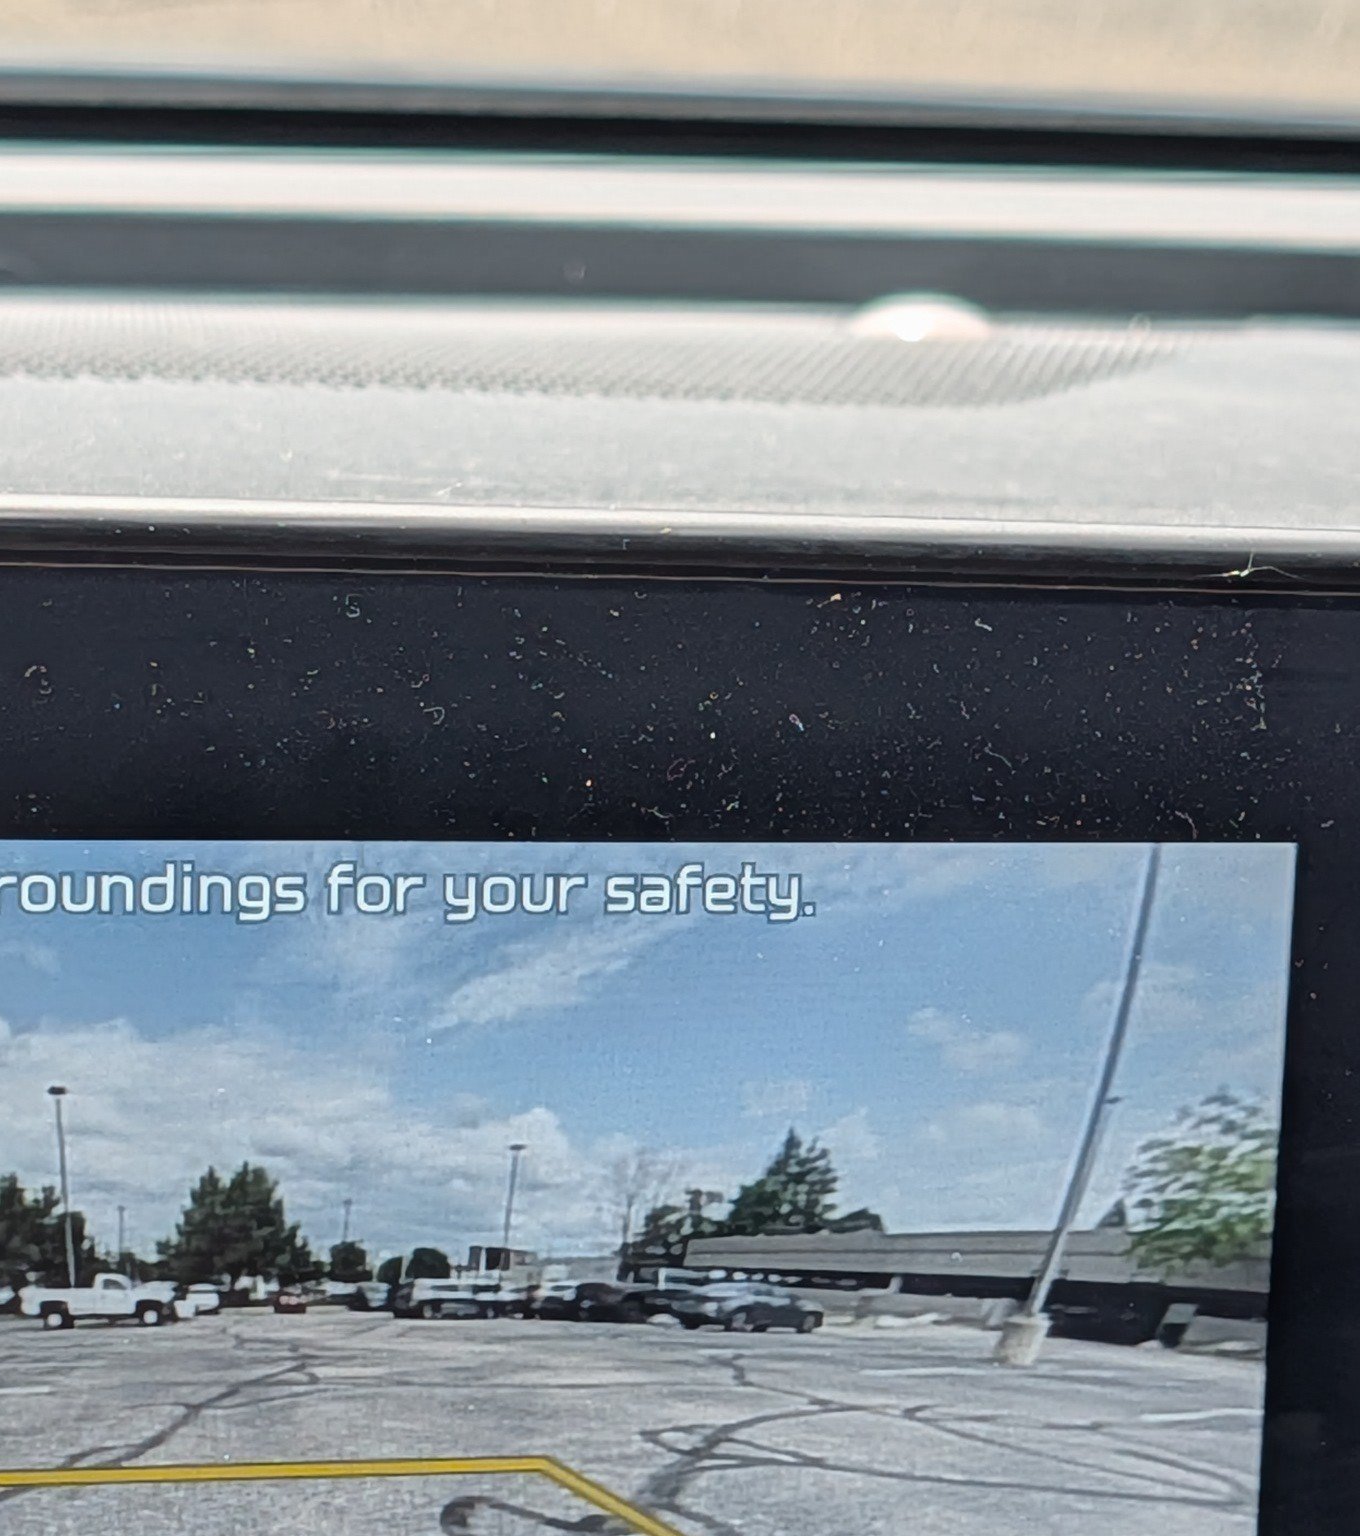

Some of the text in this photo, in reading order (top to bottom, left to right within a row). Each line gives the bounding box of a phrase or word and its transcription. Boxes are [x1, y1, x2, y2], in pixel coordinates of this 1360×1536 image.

[327, 860, 425, 914] for
[444, 873, 586, 922] your
[605, 862, 815, 922] safety.
